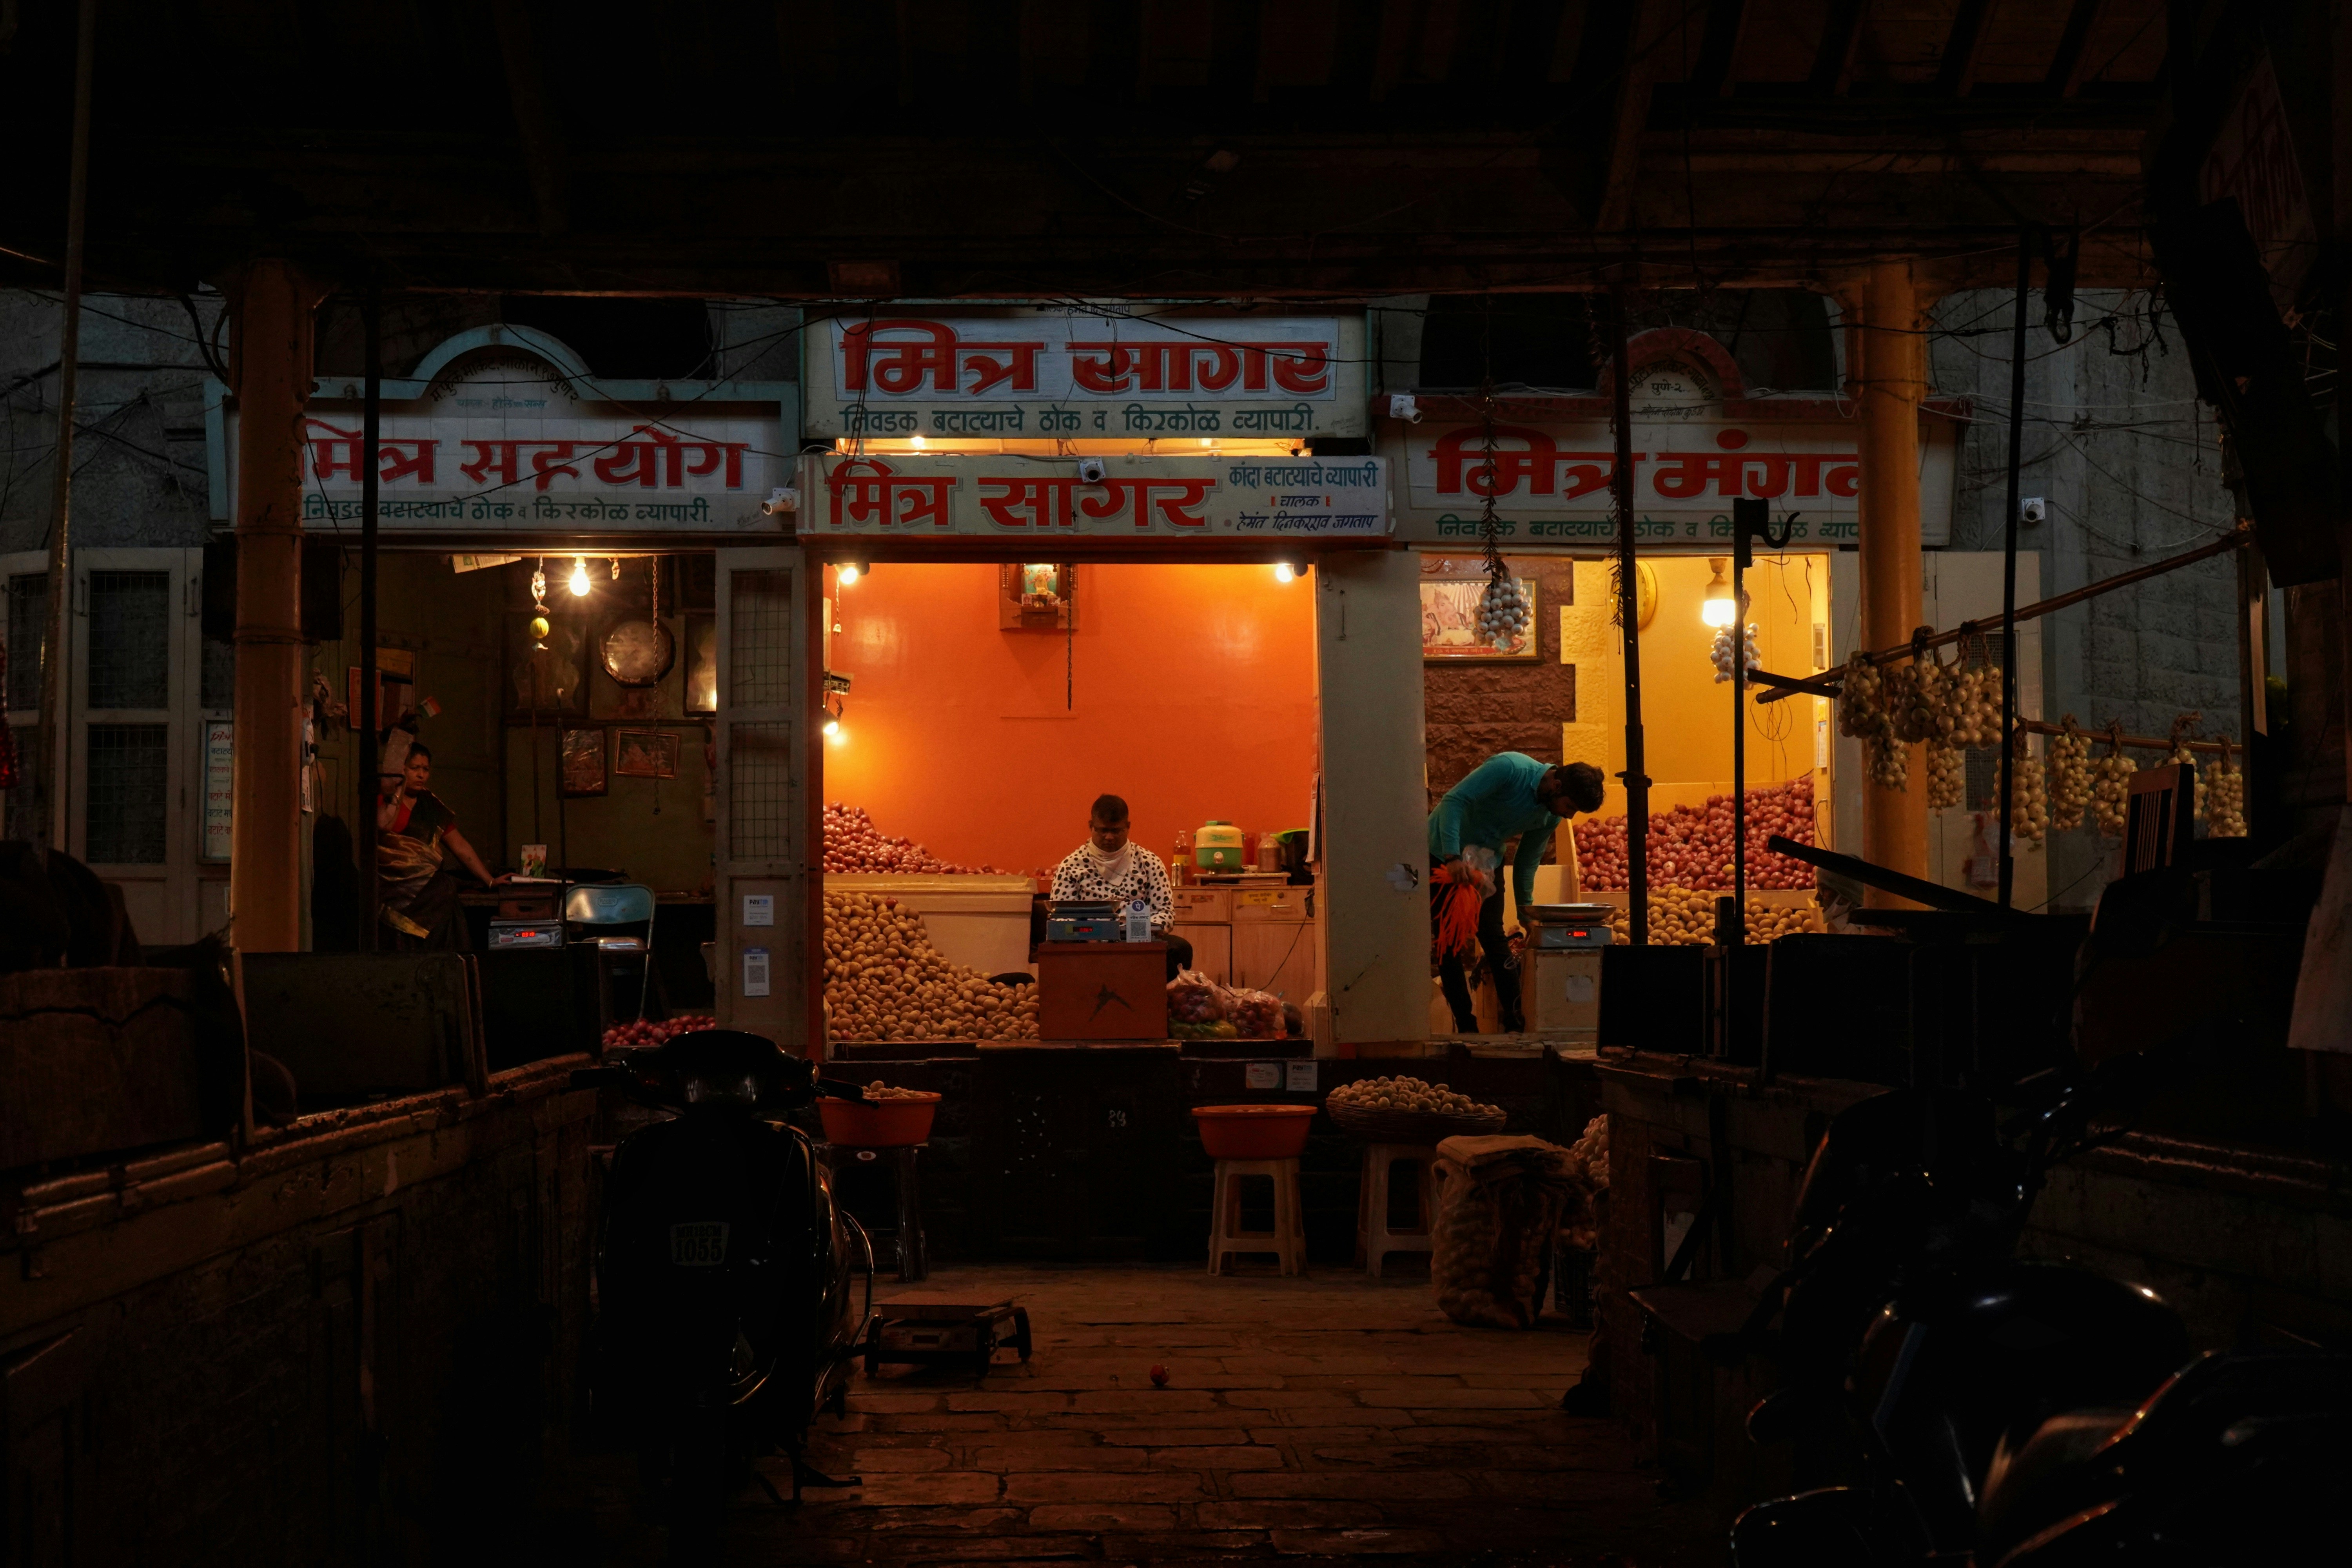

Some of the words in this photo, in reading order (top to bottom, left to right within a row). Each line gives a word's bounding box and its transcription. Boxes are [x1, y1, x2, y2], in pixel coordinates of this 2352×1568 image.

[839, 319, 1044, 395] मित्र
[1065, 341, 1329, 393] सागर
[839, 404, 918, 431] निवडक
[1039, 404, 1081, 431] ठोक
[1093, 410, 1107, 431] व
[1122, 403, 1220, 431] किरकोळ
[301, 418, 439, 483] मित्र
[460, 425, 749, 492] सहयोग
[1428, 425, 1646, 499] मित्र
[1229, 462, 1262, 488] कांदा
[1326, 461, 1379, 487] व्यापारी
[824, 459, 957, 526] मित्र
[978, 477, 1216, 526] सागर
[1280, 495, 1321, 508] चालक
[472, 495, 515, 520] ठोक
[518, 506, 526, 519] व
[532, 495, 630, 520] किरकोळ
[1236, 511, 1269, 531] हेमंत
[1333, 515, 1378, 529] जगताप
[1436, 513, 1516, 536] निवडक
[1686, 522, 1699, 537] व
[674, 1238, 722, 1262] 1055
